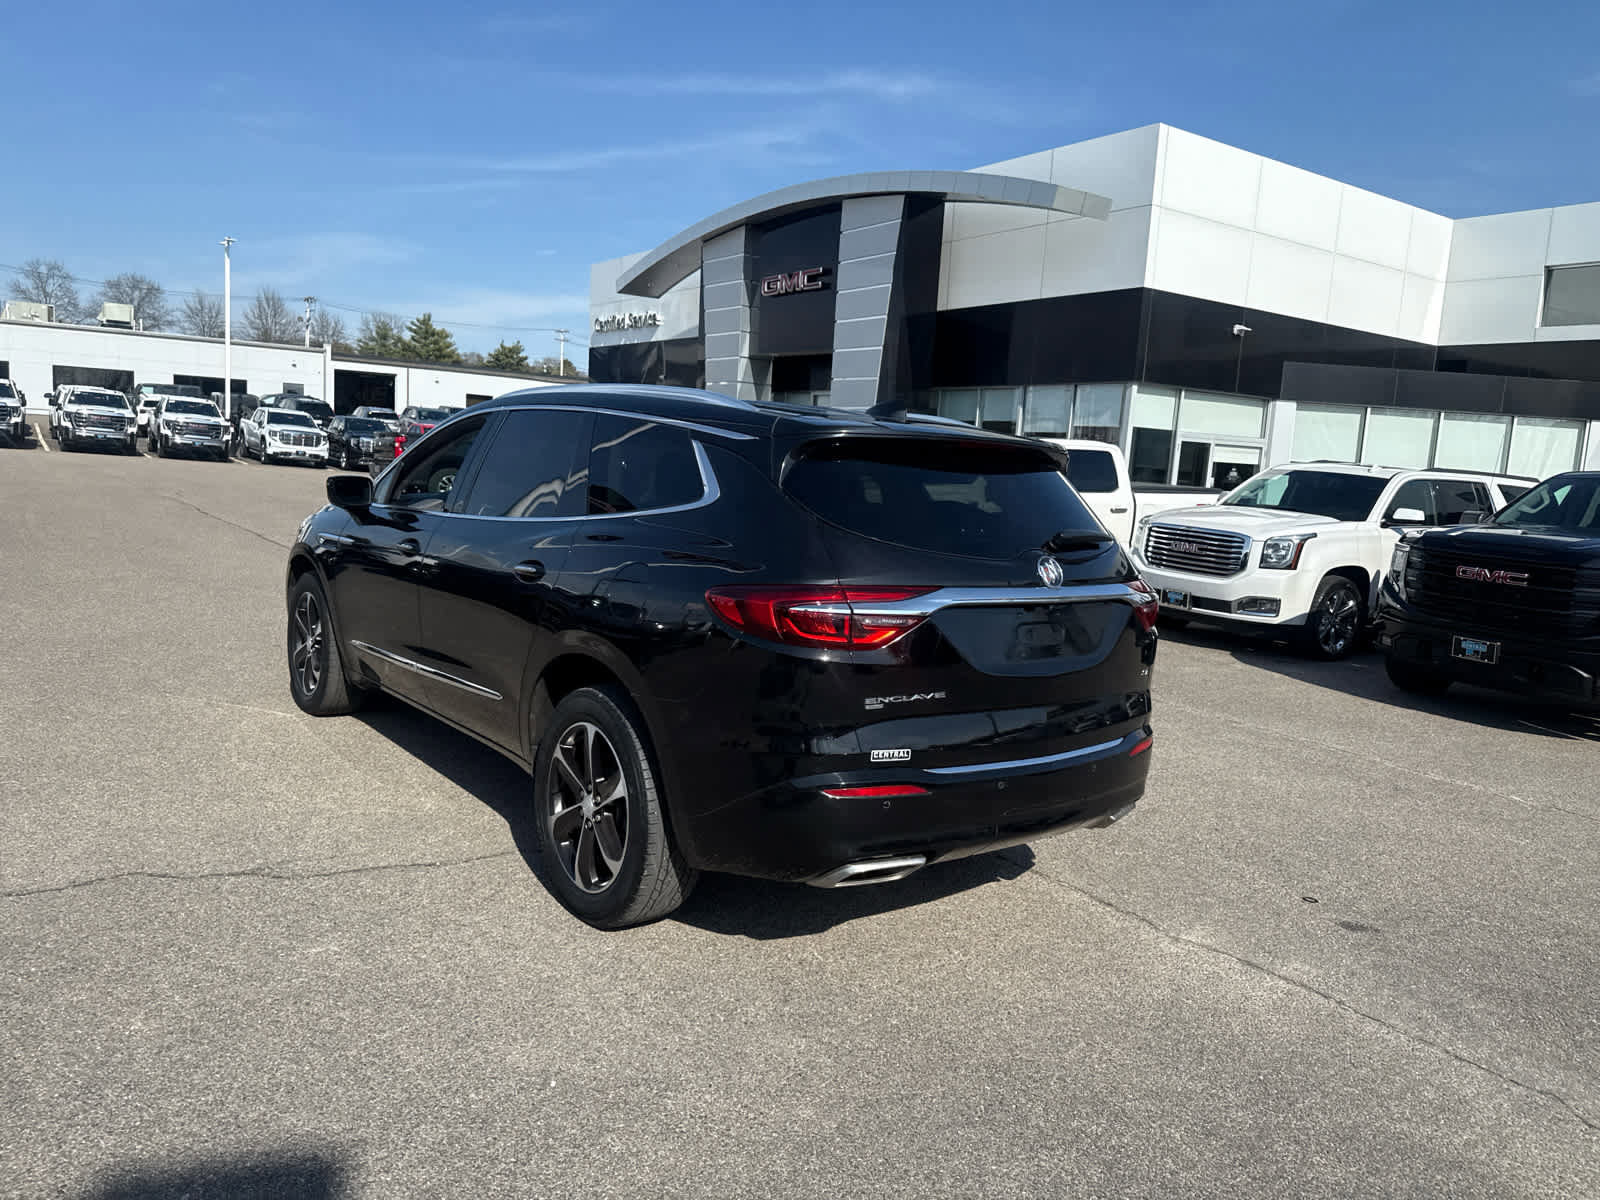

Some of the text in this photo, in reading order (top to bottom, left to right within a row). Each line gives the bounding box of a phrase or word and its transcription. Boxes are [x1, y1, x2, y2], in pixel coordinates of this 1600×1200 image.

[761, 267, 823, 296] GMC
[594, 311, 660, 333] Certified Service
[1171, 541, 1208, 554] GMC
[1456, 565, 1529, 586] GMC
[864, 691, 947, 705] ENCLAVE
[872, 750, 910, 760] CENTRAL
